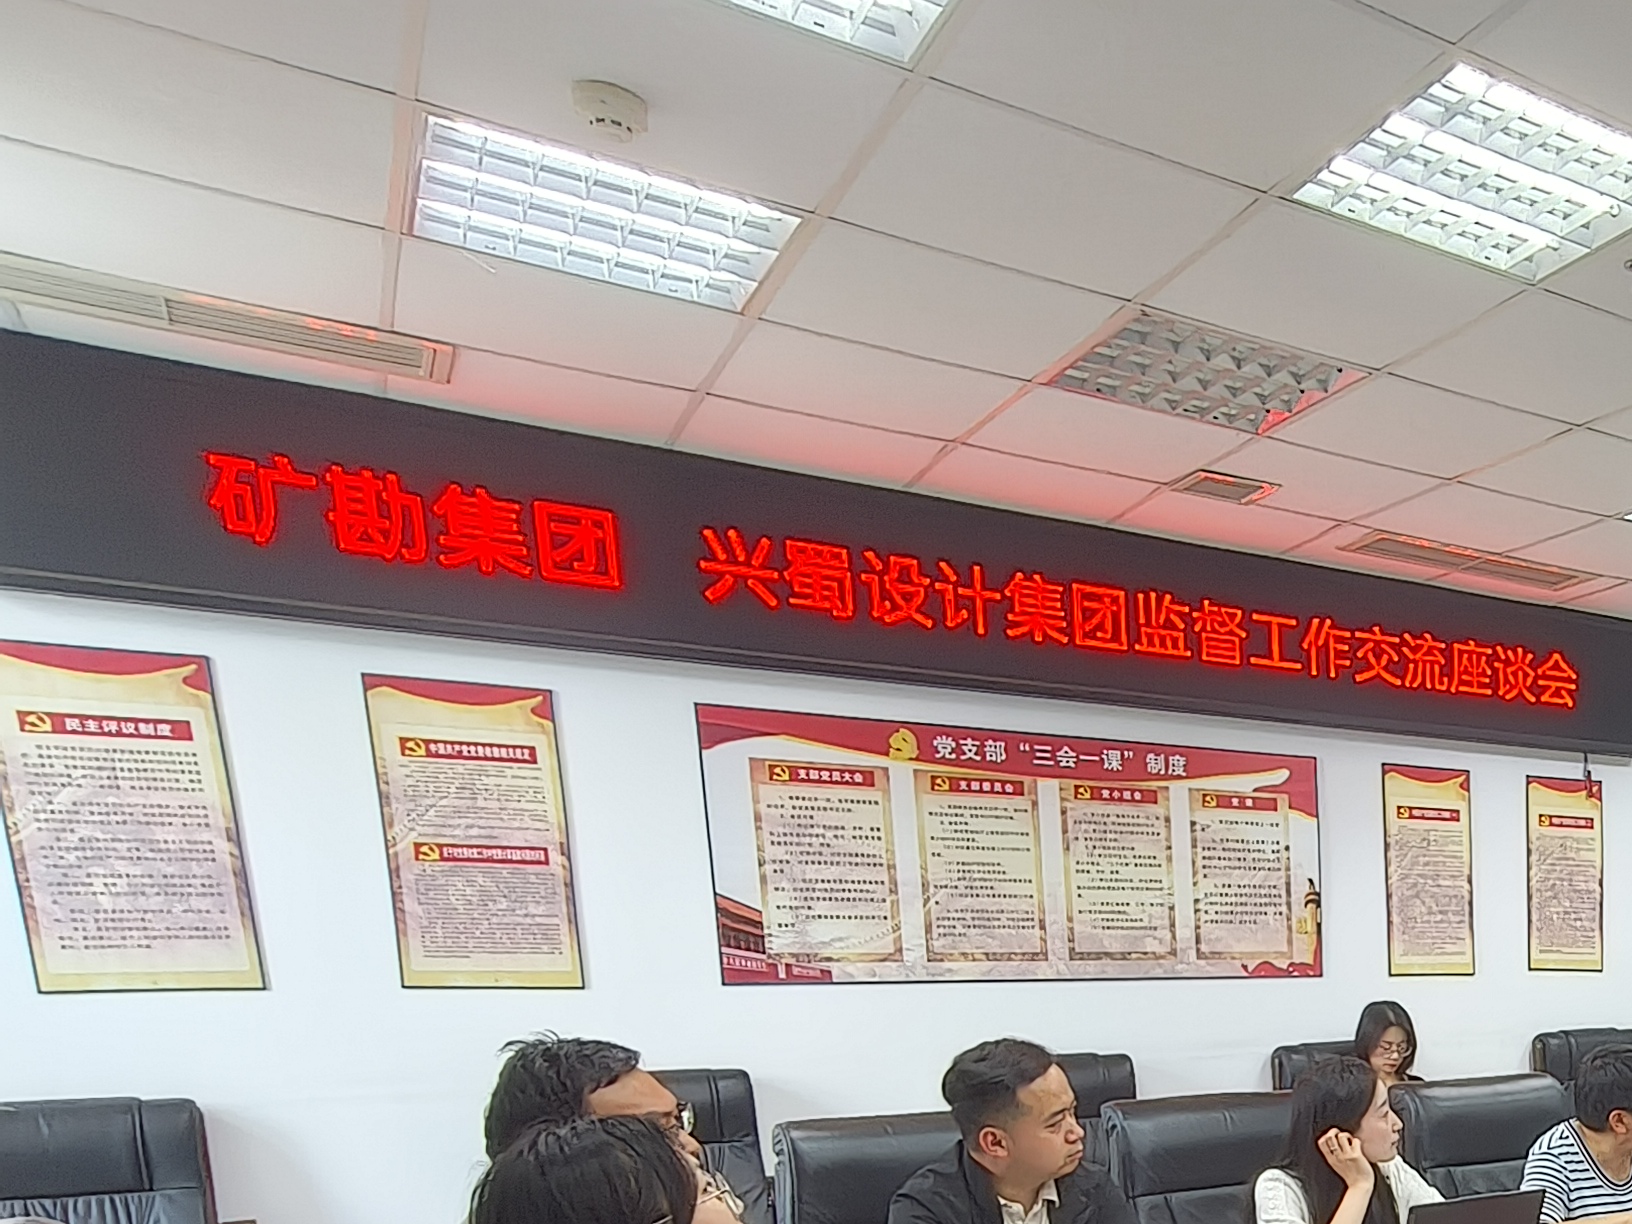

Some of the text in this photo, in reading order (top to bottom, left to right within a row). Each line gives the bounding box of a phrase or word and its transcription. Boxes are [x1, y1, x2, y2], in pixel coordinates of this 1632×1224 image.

[203, 452, 1579, 709] 矿勘集团 兴蜀设计集团监督工作交流座谈会
[64, 717, 174, 737] 民主评议制度
[798, 768, 864, 783] 支部党员大会
